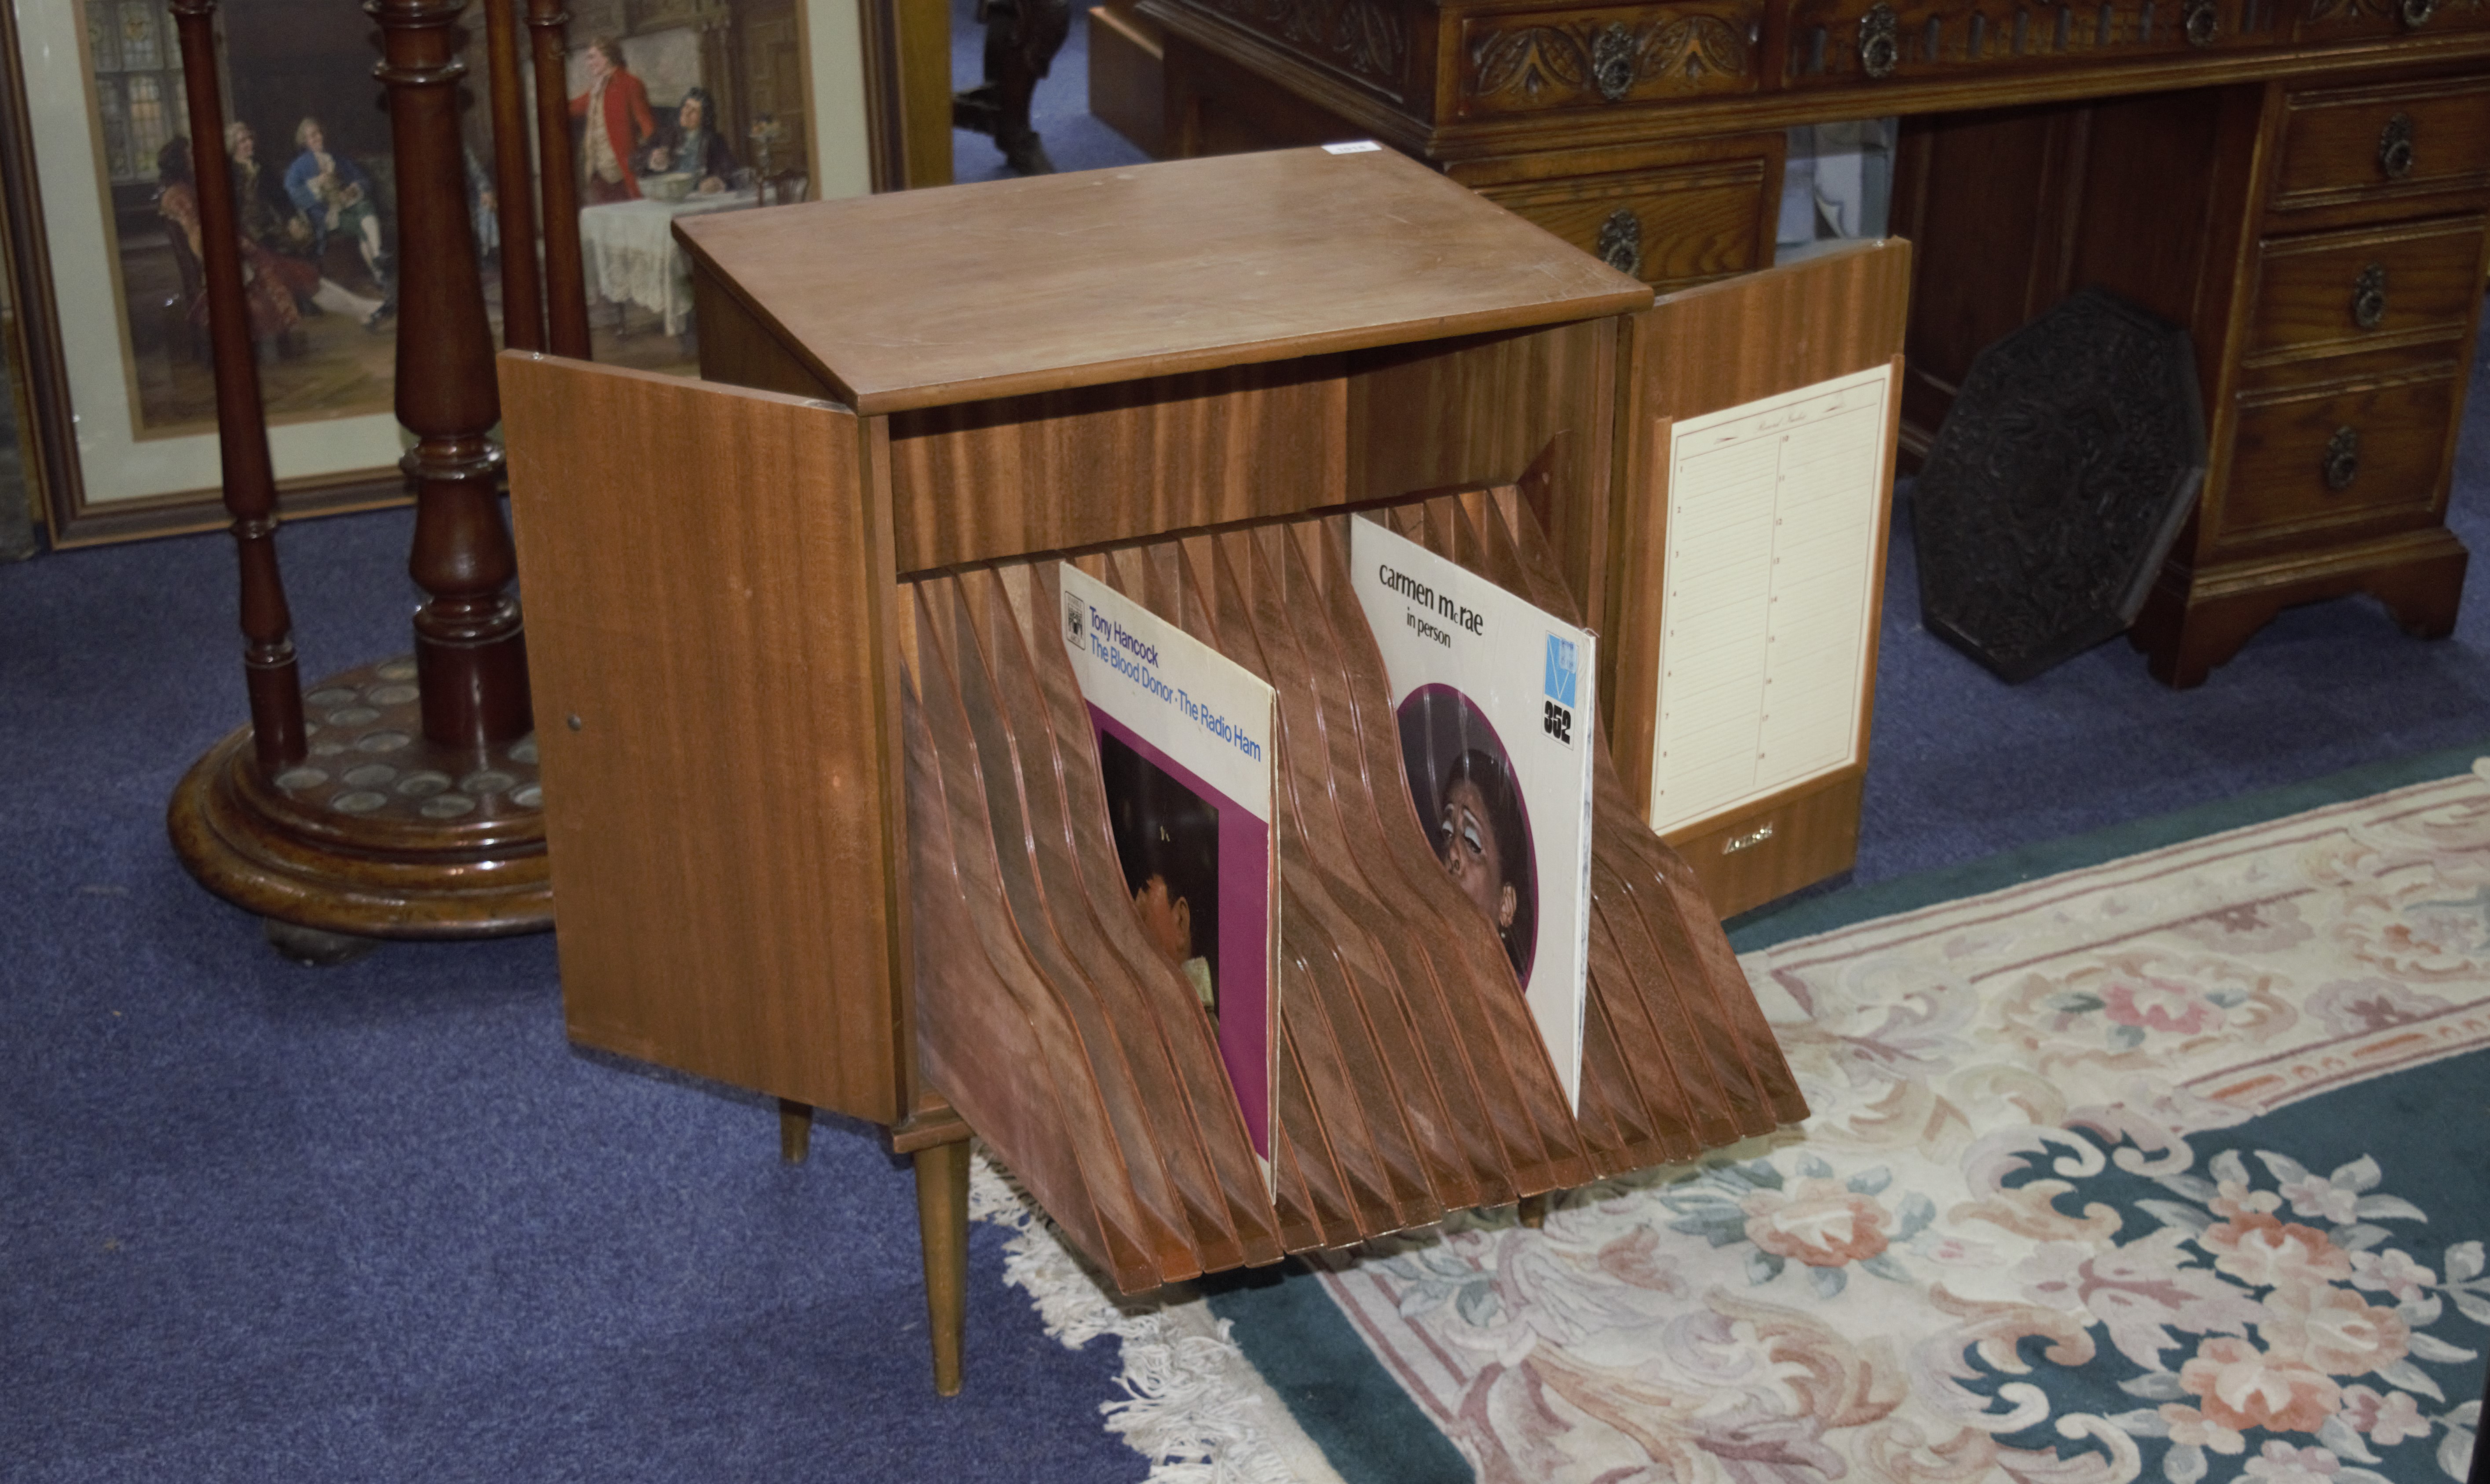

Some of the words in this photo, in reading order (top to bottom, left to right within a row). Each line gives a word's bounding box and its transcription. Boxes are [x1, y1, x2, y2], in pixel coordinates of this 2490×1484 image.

[1379, 565, 1433, 610] carmen
[1090, 605, 1112, 642] Tony
[1114, 621, 1159, 669] Hancock
[1407, 606, 1415, 629] in
[1418, 618, 1451, 648] person
[1090, 633, 1109, 663] The
[1111, 646, 1140, 684] Blood
[1142, 665, 1174, 704] Donor
[1178, 688, 1198, 721] The
[1201, 704, 1232, 742] Radio
[1234, 725, 1261, 762] Ham
[1544, 700, 1572, 745] 352
